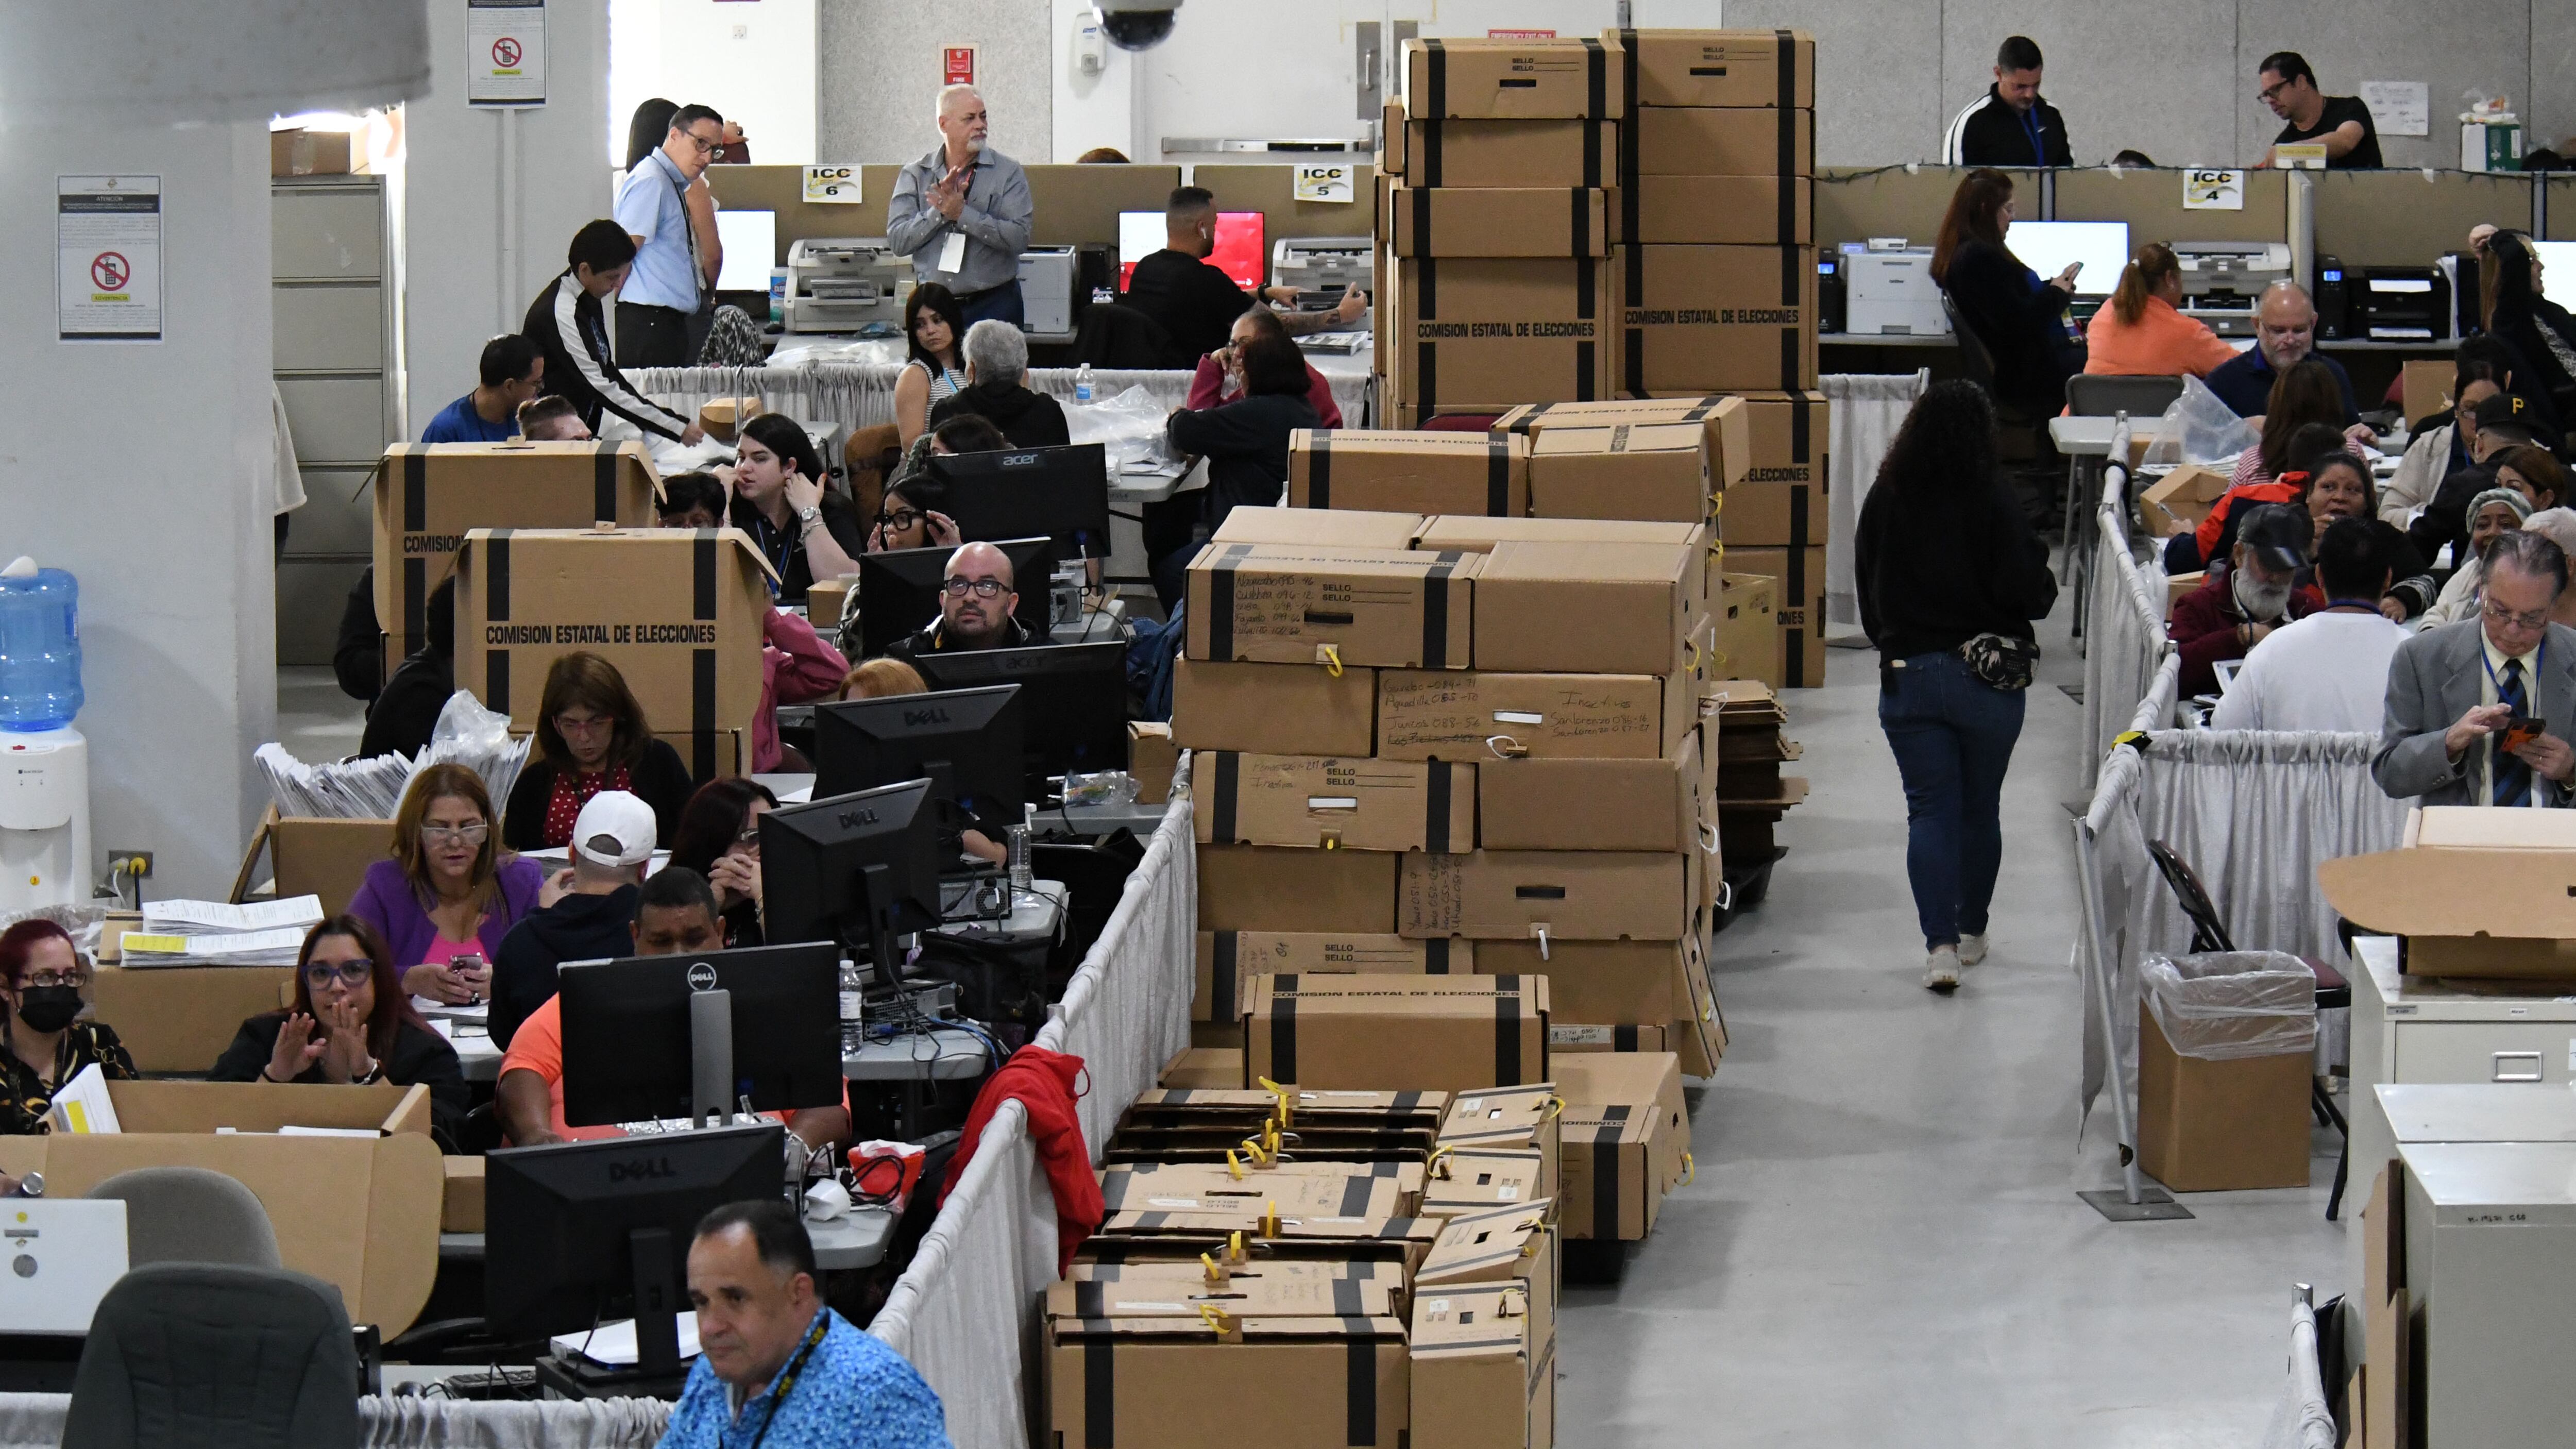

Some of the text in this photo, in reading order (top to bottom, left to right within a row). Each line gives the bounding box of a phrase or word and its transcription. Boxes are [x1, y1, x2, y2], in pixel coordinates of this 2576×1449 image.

[813, 169, 851, 178] ICC
[1303, 169, 1342, 179] ICC
[2194, 173, 2232, 183] ICC
[825, 186, 838, 195] 6
[1317, 187, 1329, 195] 5
[2206, 191, 2219, 200] 4
[1625, 310, 1799, 324] COMISION ESTATAL DE ELECCIONES
[1418, 323, 1594, 338] COMISION ESTATAL DE ELECCIONES
[2512, 397, 2524, 414] P
[1003, 454, 1038, 465] acer
[1749, 468, 1809, 482] ELECCIONES
[486, 625, 715, 644] COMISION ESTATAL DE ELECCIONES
[904, 708, 951, 726] DELL
[839, 807, 879, 829] DELL
[691, 972, 713, 982] DELL
[609, 1157, 676, 1181] DELL
